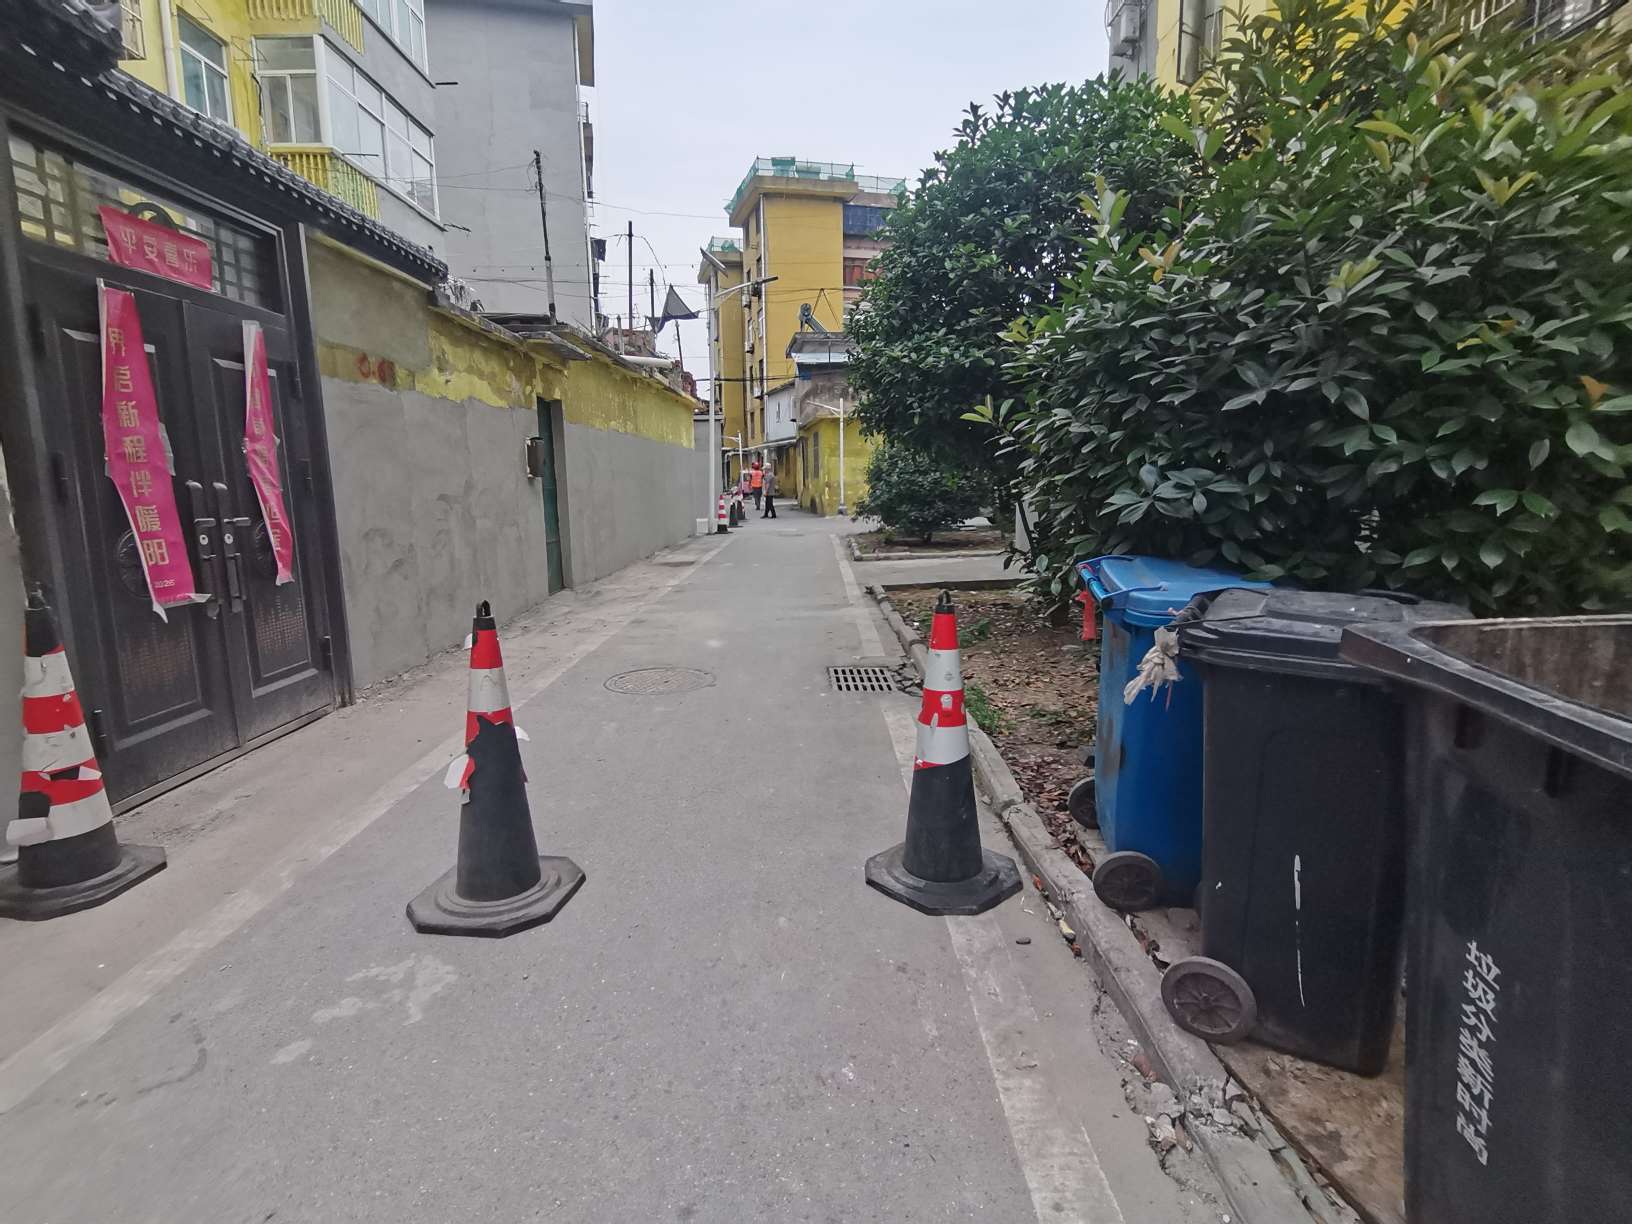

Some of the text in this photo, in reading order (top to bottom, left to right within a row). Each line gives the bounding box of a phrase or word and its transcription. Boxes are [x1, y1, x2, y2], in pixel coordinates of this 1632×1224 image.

[119, 226, 199, 274] 平安喜乐
[1455, 938, 1501, 1166] 垃圾分类新时尚
